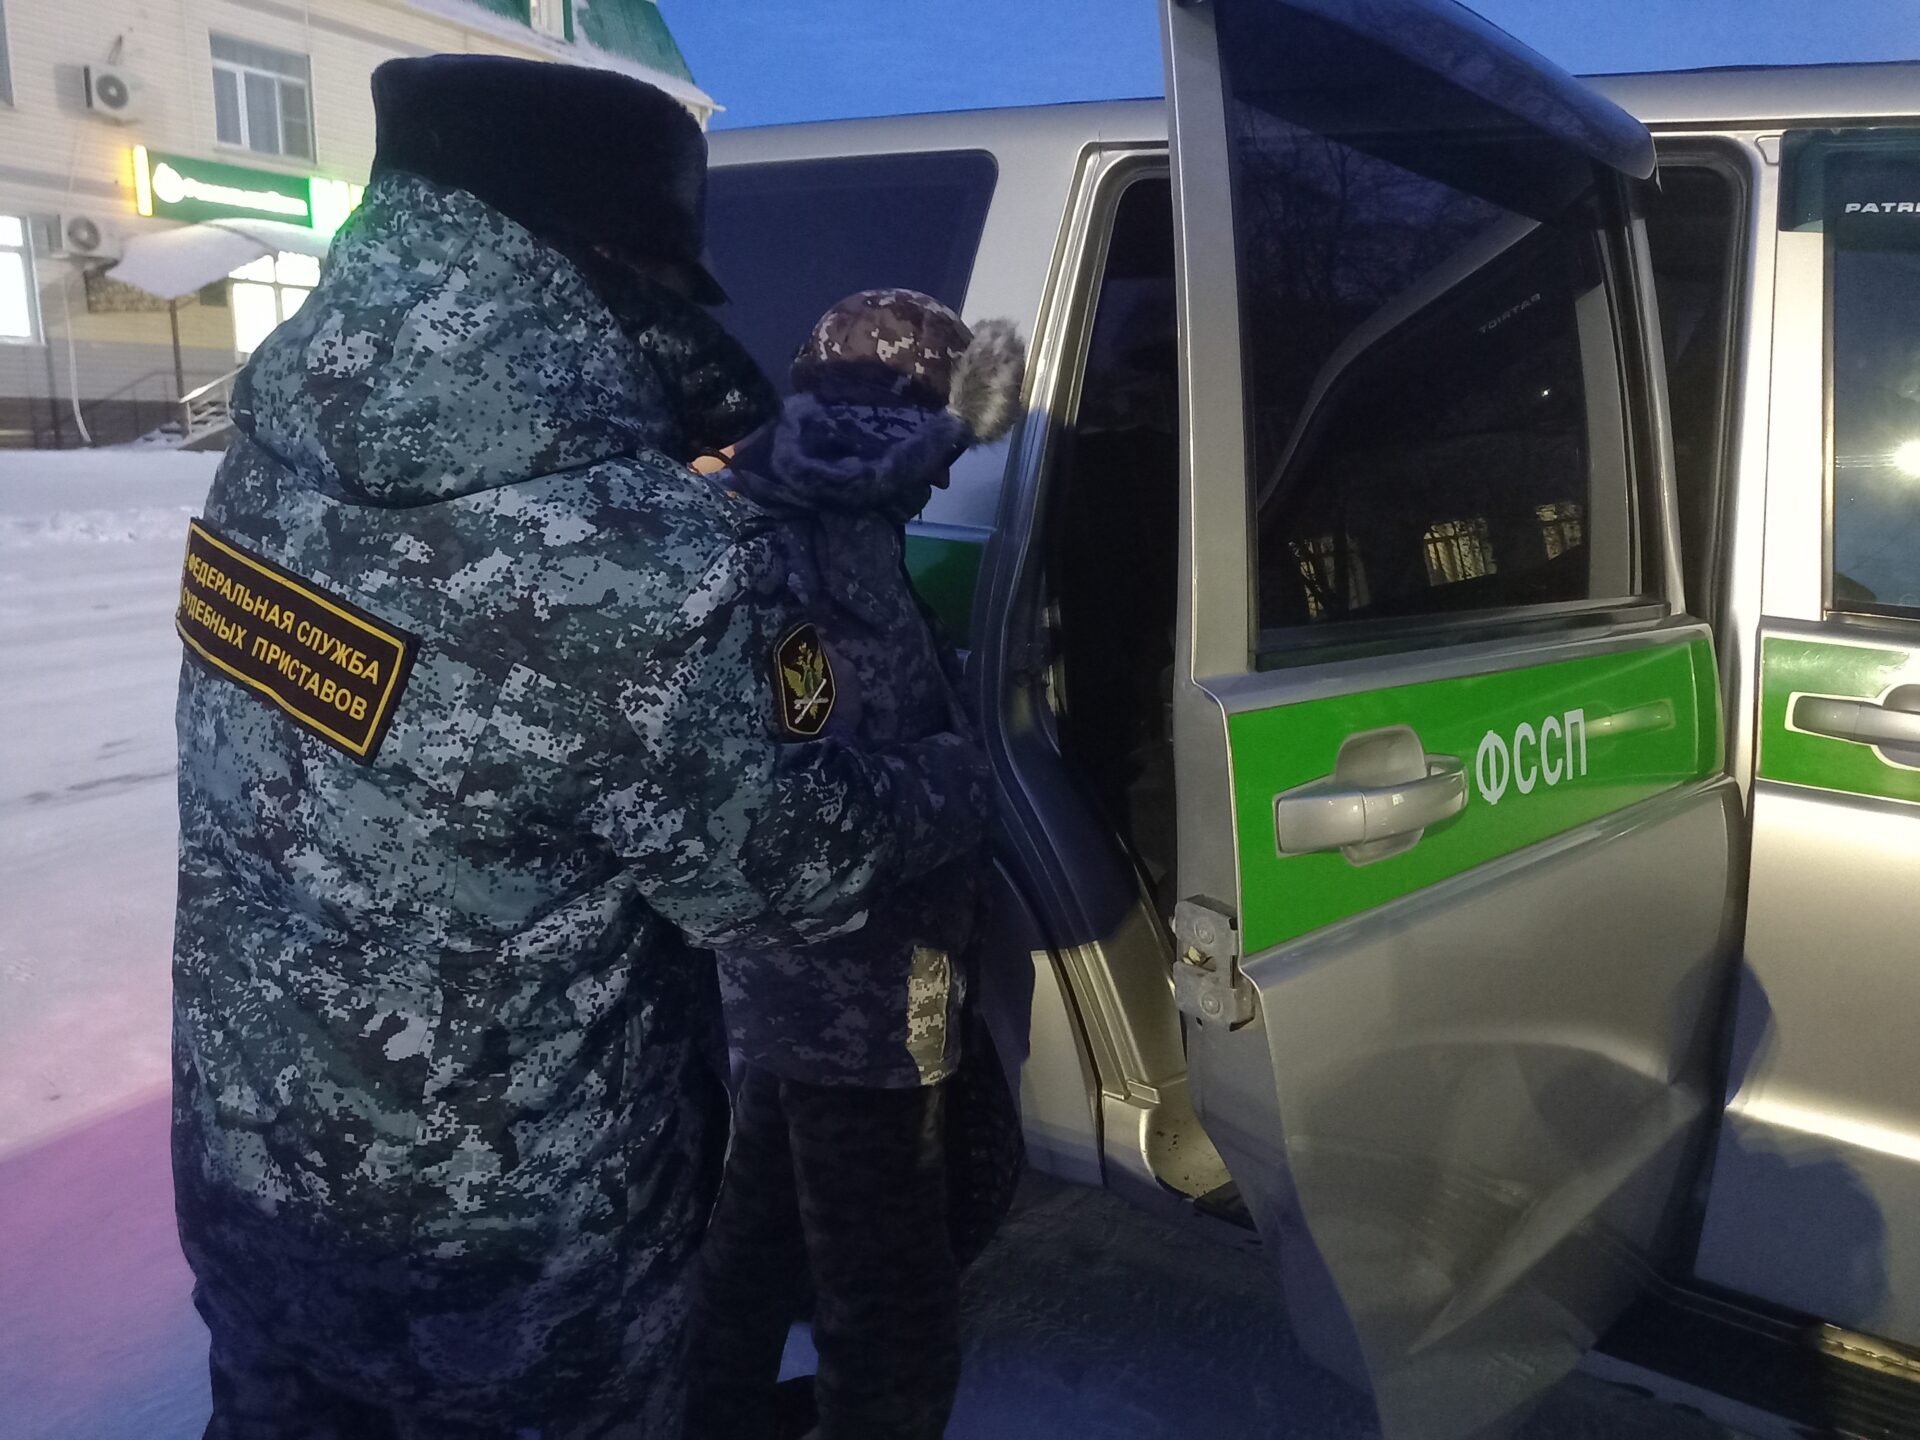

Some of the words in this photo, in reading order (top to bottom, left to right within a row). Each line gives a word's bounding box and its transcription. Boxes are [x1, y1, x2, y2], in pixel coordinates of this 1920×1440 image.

[188, 553, 295, 634] ФЕДЕРАЛЬНАЯ
[296, 621, 380, 685] СЛУЖБА
[251, 636, 368, 721] ПРИСТАВОВ
[1475, 708, 1587, 806] ФССП
